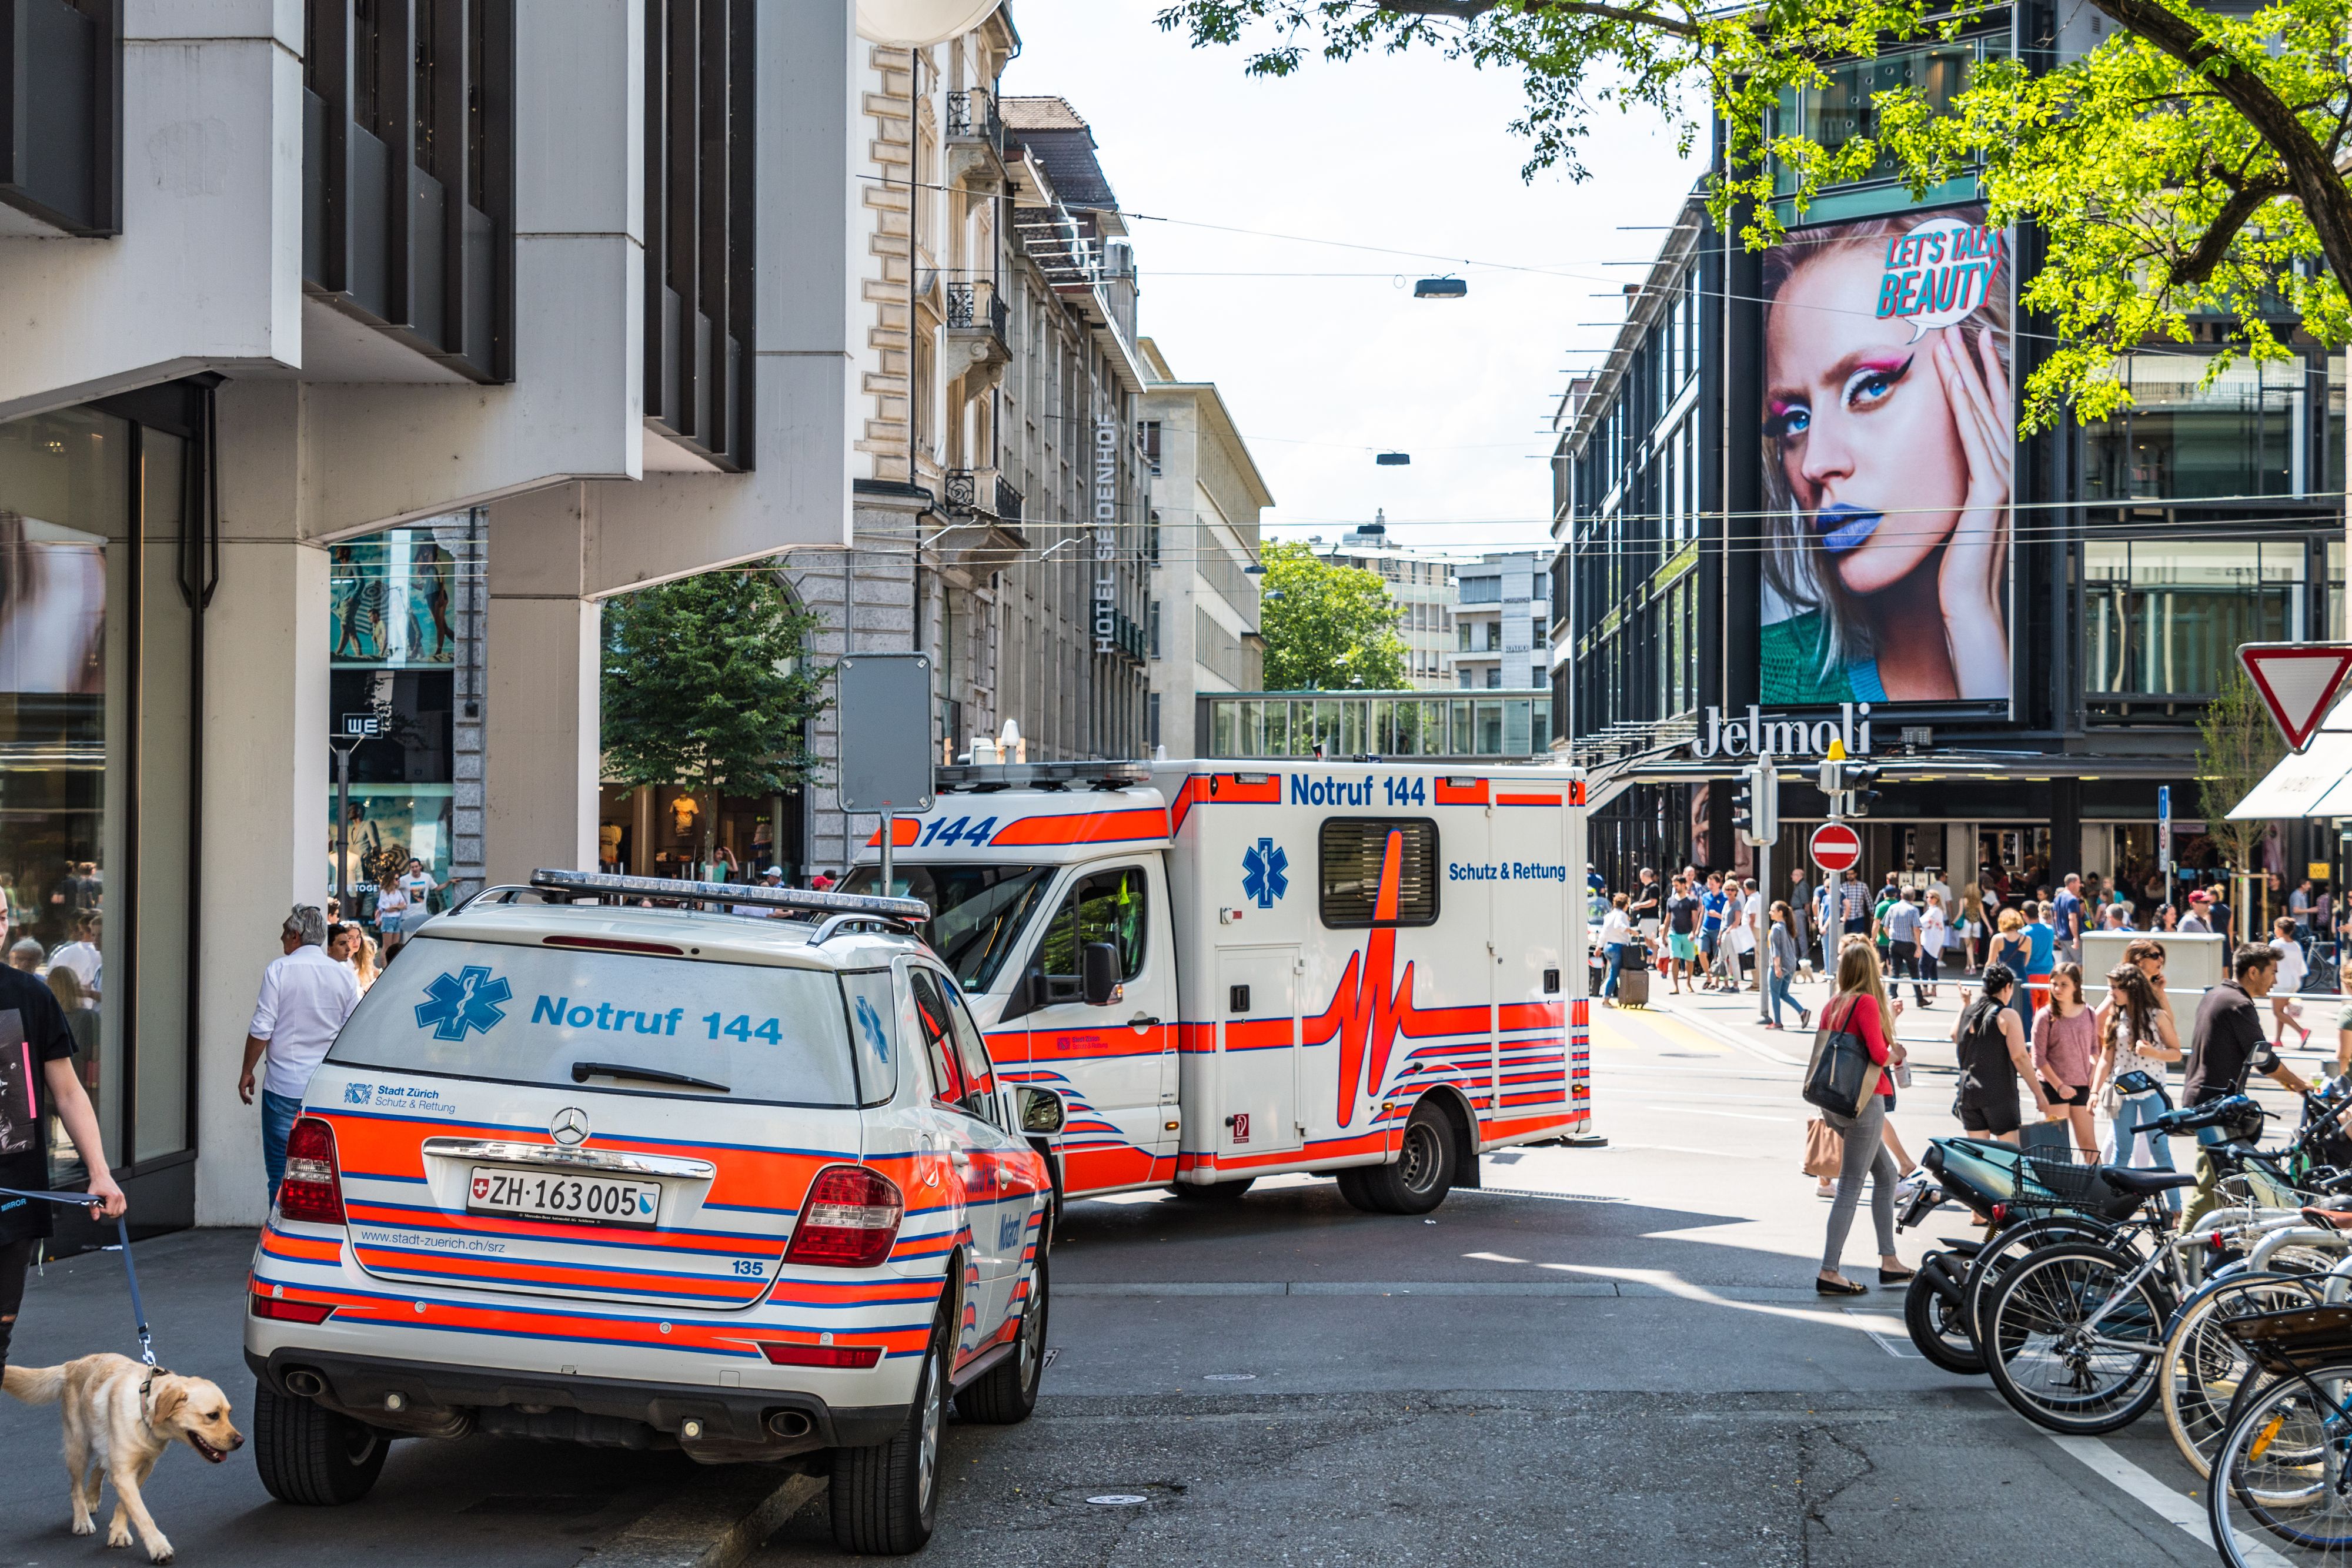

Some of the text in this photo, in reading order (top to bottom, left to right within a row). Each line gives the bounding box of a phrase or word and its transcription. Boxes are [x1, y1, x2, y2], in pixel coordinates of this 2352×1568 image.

[1885, 225, 2003, 269] LET'S TALK
[1876, 259, 2003, 320] BEAUTY
[1095, 572, 1114, 653] HOTEL
[348, 719, 378, 733] WE
[1692, 702, 1871, 758] Jelmoli
[1291, 774, 1425, 806] Notruf 144
[920, 816, 998, 847] 144
[1449, 862, 1566, 882] Schutz & Rettung
[531, 995, 783, 1045] Notruf 144
[375, 1096, 456, 1114] Schutz & Rettung
[378, 1085, 439, 1099] Stadt Zürich
[362, 1231, 506, 1253] www.stadt-zuerich.ch/srz
[998, 1211, 1021, 1252] Notarzt
[733, 1260, 763, 1276] 135
